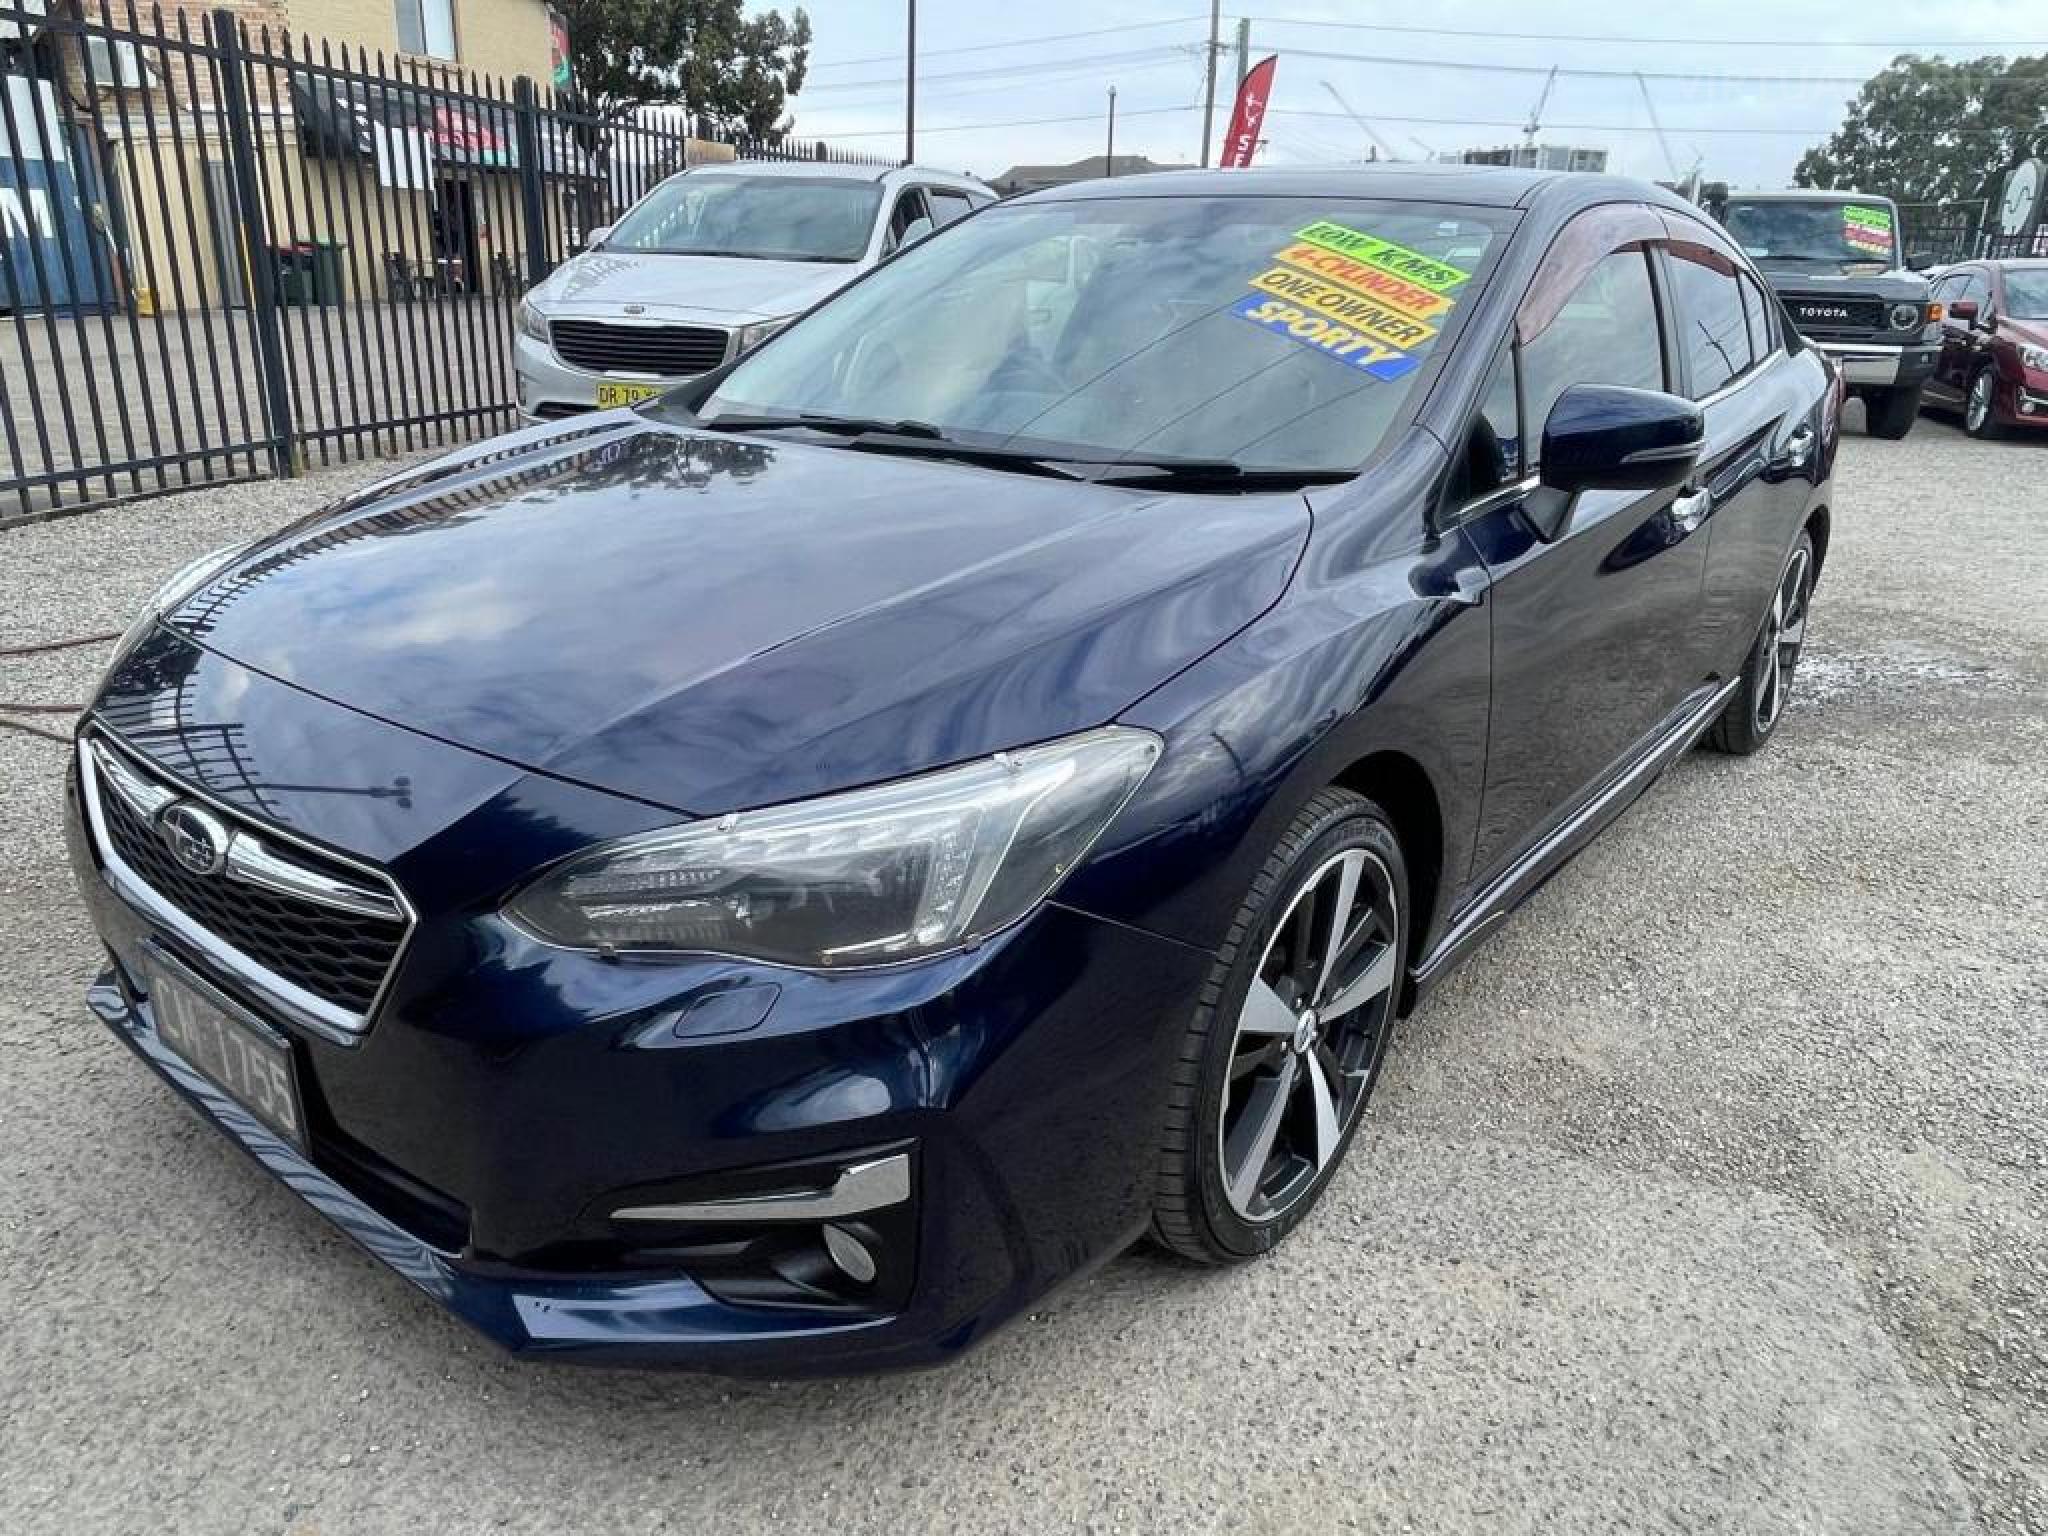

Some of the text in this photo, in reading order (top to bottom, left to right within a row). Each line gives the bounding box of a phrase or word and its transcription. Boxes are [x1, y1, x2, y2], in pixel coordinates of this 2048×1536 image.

[1374, 248, 1454, 286] KMS
[1261, 271, 1426, 343] ONE OWNER
[1799, 307, 1849, 318] TOYOTA
[1246, 301, 1408, 366] SPORTY
